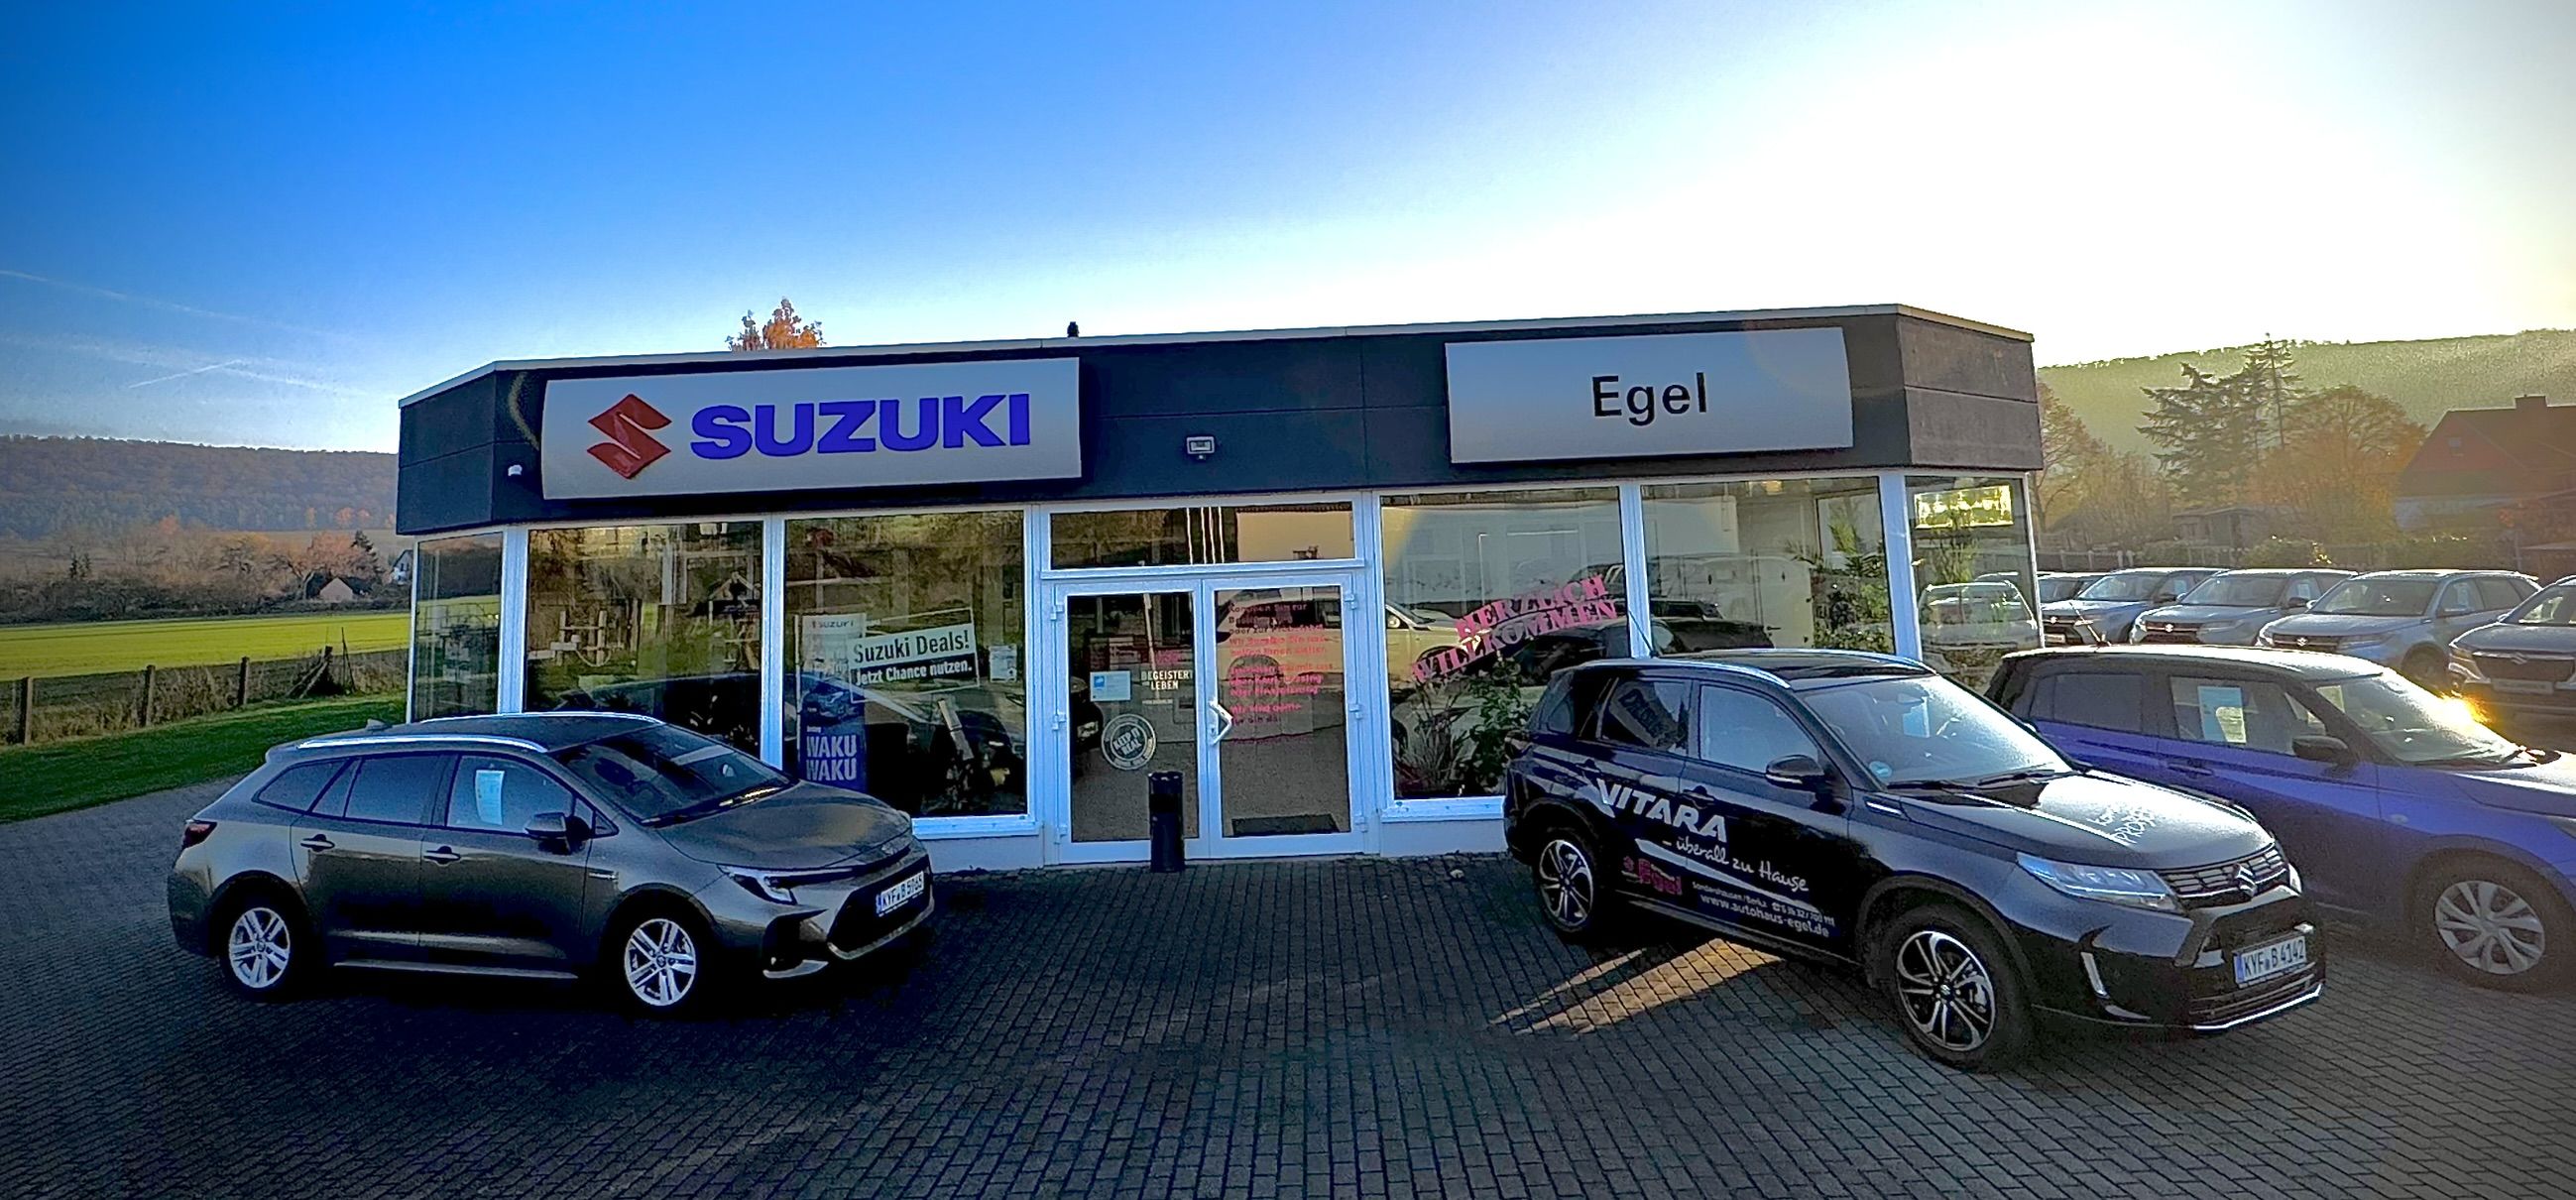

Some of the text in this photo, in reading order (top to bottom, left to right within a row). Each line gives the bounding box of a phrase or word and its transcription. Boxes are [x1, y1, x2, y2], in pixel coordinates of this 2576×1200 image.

[1591, 372, 1707, 426] Egel
[689, 393, 1030, 460] SUZUKI
[1455, 574, 1608, 640] HERZLICH
[854, 630, 970, 663] Suzuki Deals!
[1412, 599, 1618, 683] WILLKOMMEN
[856, 660, 973, 686] Jetzt Chance nutzen.
[1151, 680, 1179, 690] LEBEN
[806, 735, 858, 758] WAKU
[806, 758, 858, 780] WAKU
[1596, 778, 1727, 843] VITARA
[1676, 836, 1730, 865] überall
[1733, 858, 1754, 874] zu
[1758, 861, 1810, 892] Hause
[1699, 895, 1830, 938] www.autohaus-egel.de
[2244, 951, 2264, 978] KYF
[2271, 947, 2279, 969] B
